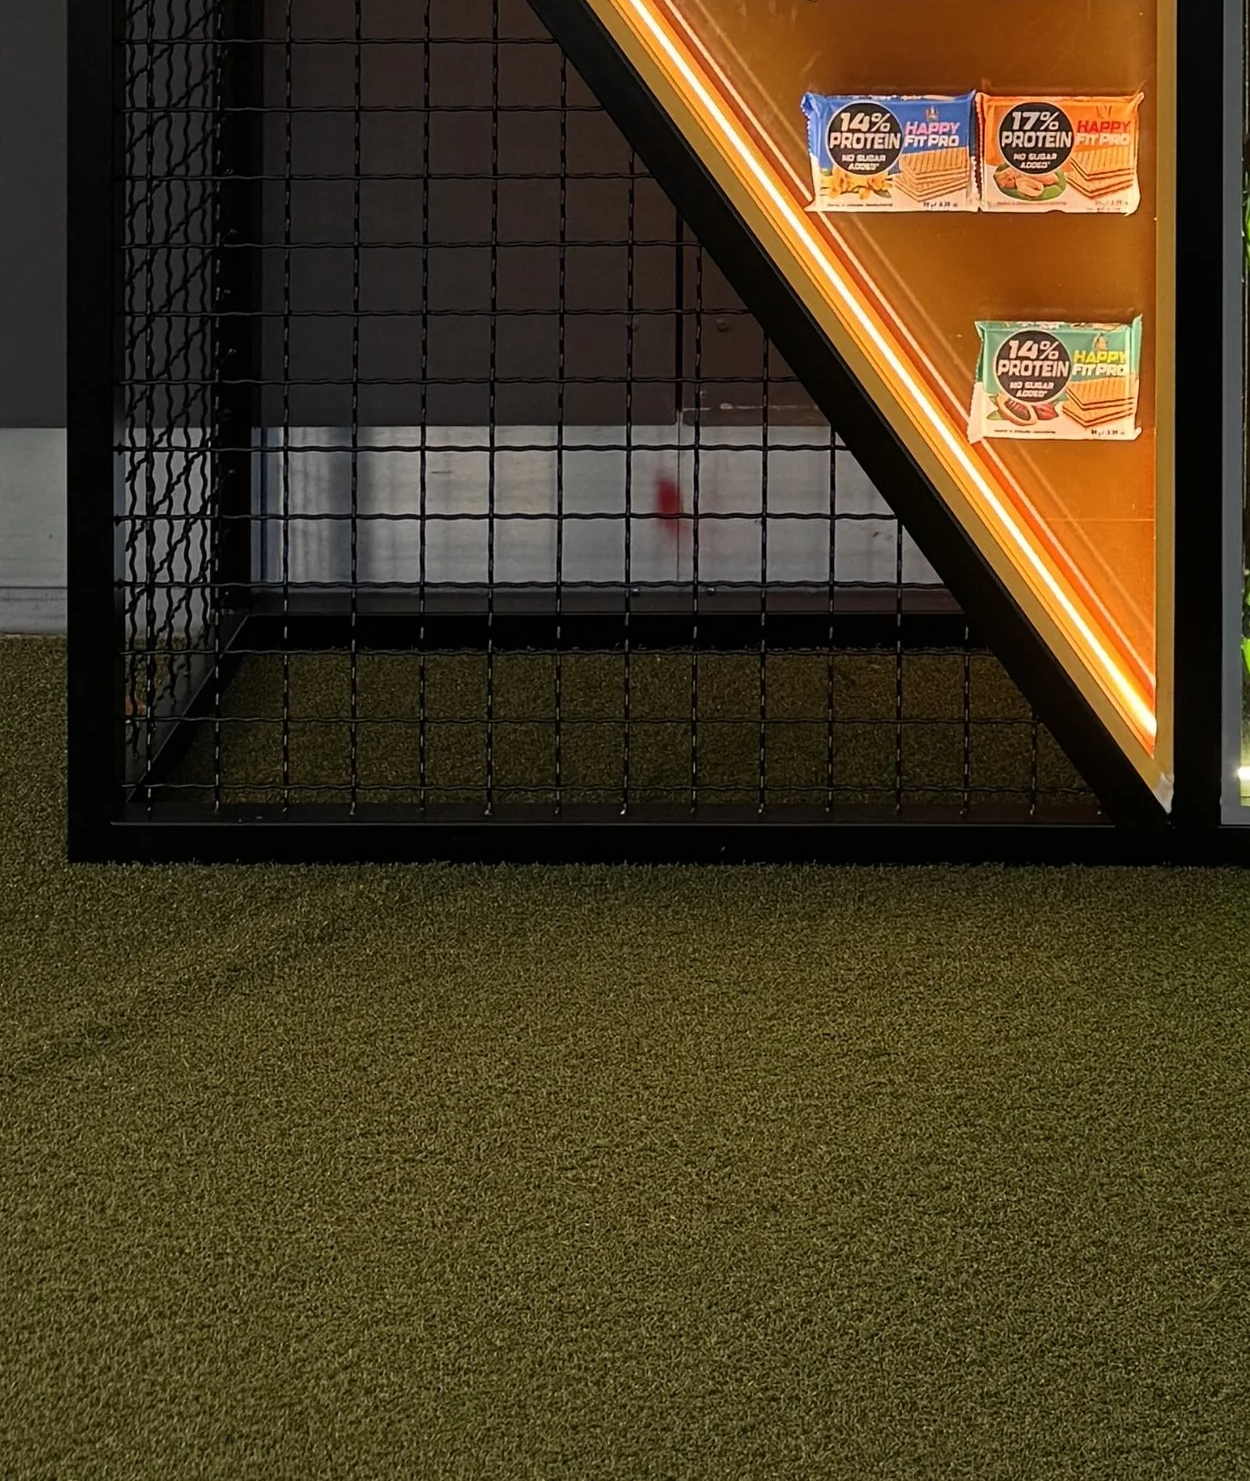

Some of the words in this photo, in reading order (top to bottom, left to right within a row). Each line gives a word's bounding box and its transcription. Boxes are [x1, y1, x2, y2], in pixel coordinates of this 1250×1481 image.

[840, 111, 891, 132] 14%
[905, 121, 959, 135] HAPPY
[1011, 111, 1058, 131] 17%
[1077, 119, 1129, 133] HAPPY
[830, 132, 901, 150] PROTEIN
[1001, 132, 1072, 148] PROTEIN
[1008, 339, 1059, 360] 14%
[1074, 350, 1127, 364] HAPPY
[998, 360, 1069, 377] PROTEIN
